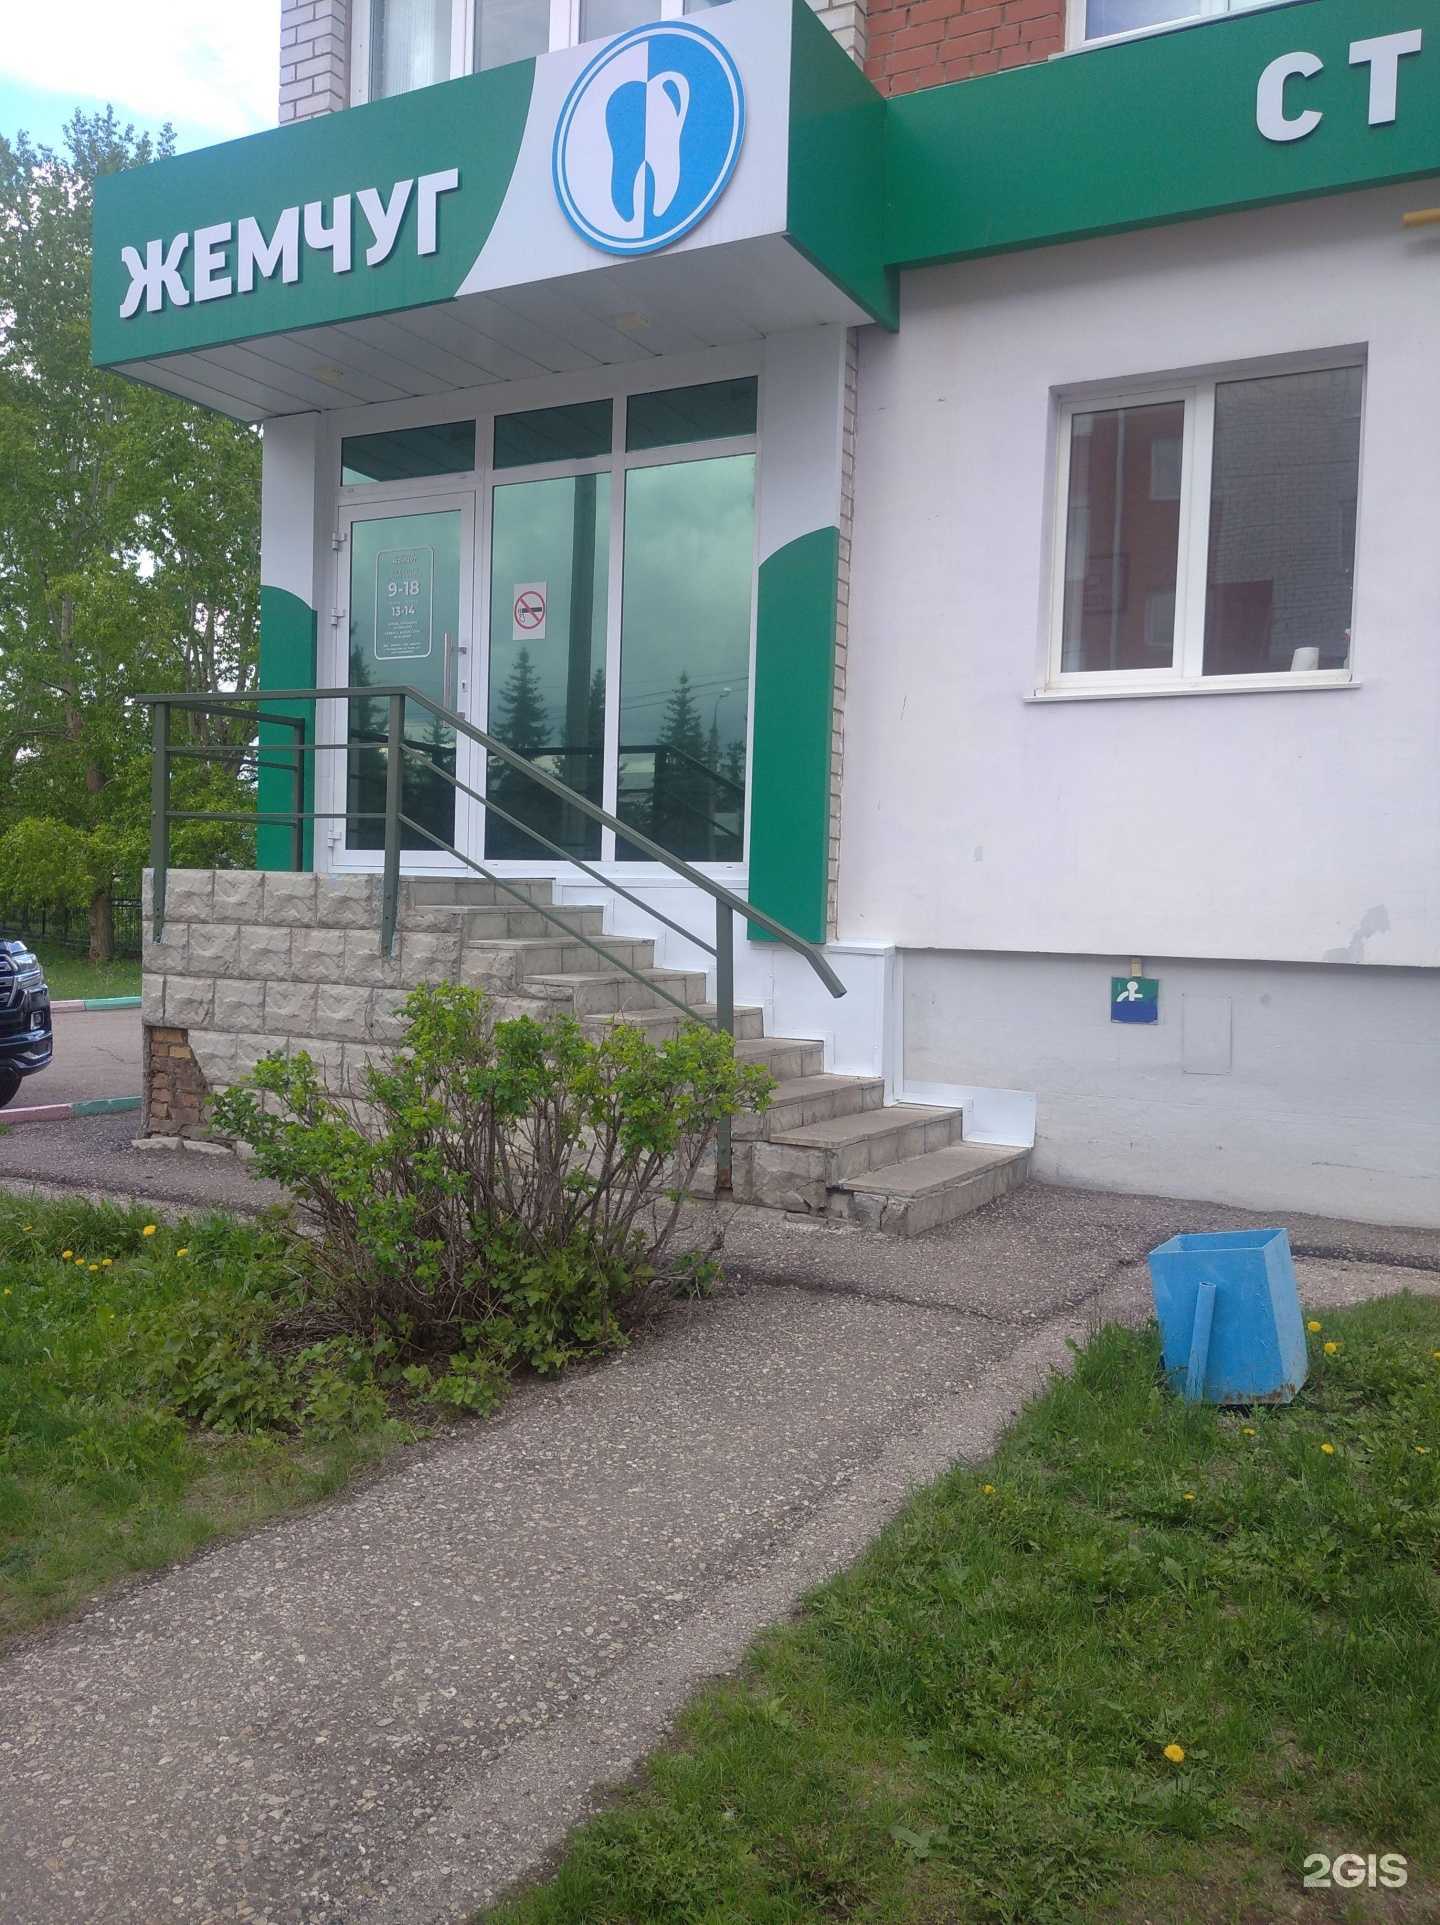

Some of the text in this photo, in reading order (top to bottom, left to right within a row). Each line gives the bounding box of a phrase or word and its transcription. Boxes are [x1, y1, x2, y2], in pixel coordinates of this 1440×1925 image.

[1256, 28, 1423, 142] СТ
[119, 167, 460, 319] ЖЕМЧУГ
[388, 580, 420, 597] 9-18
